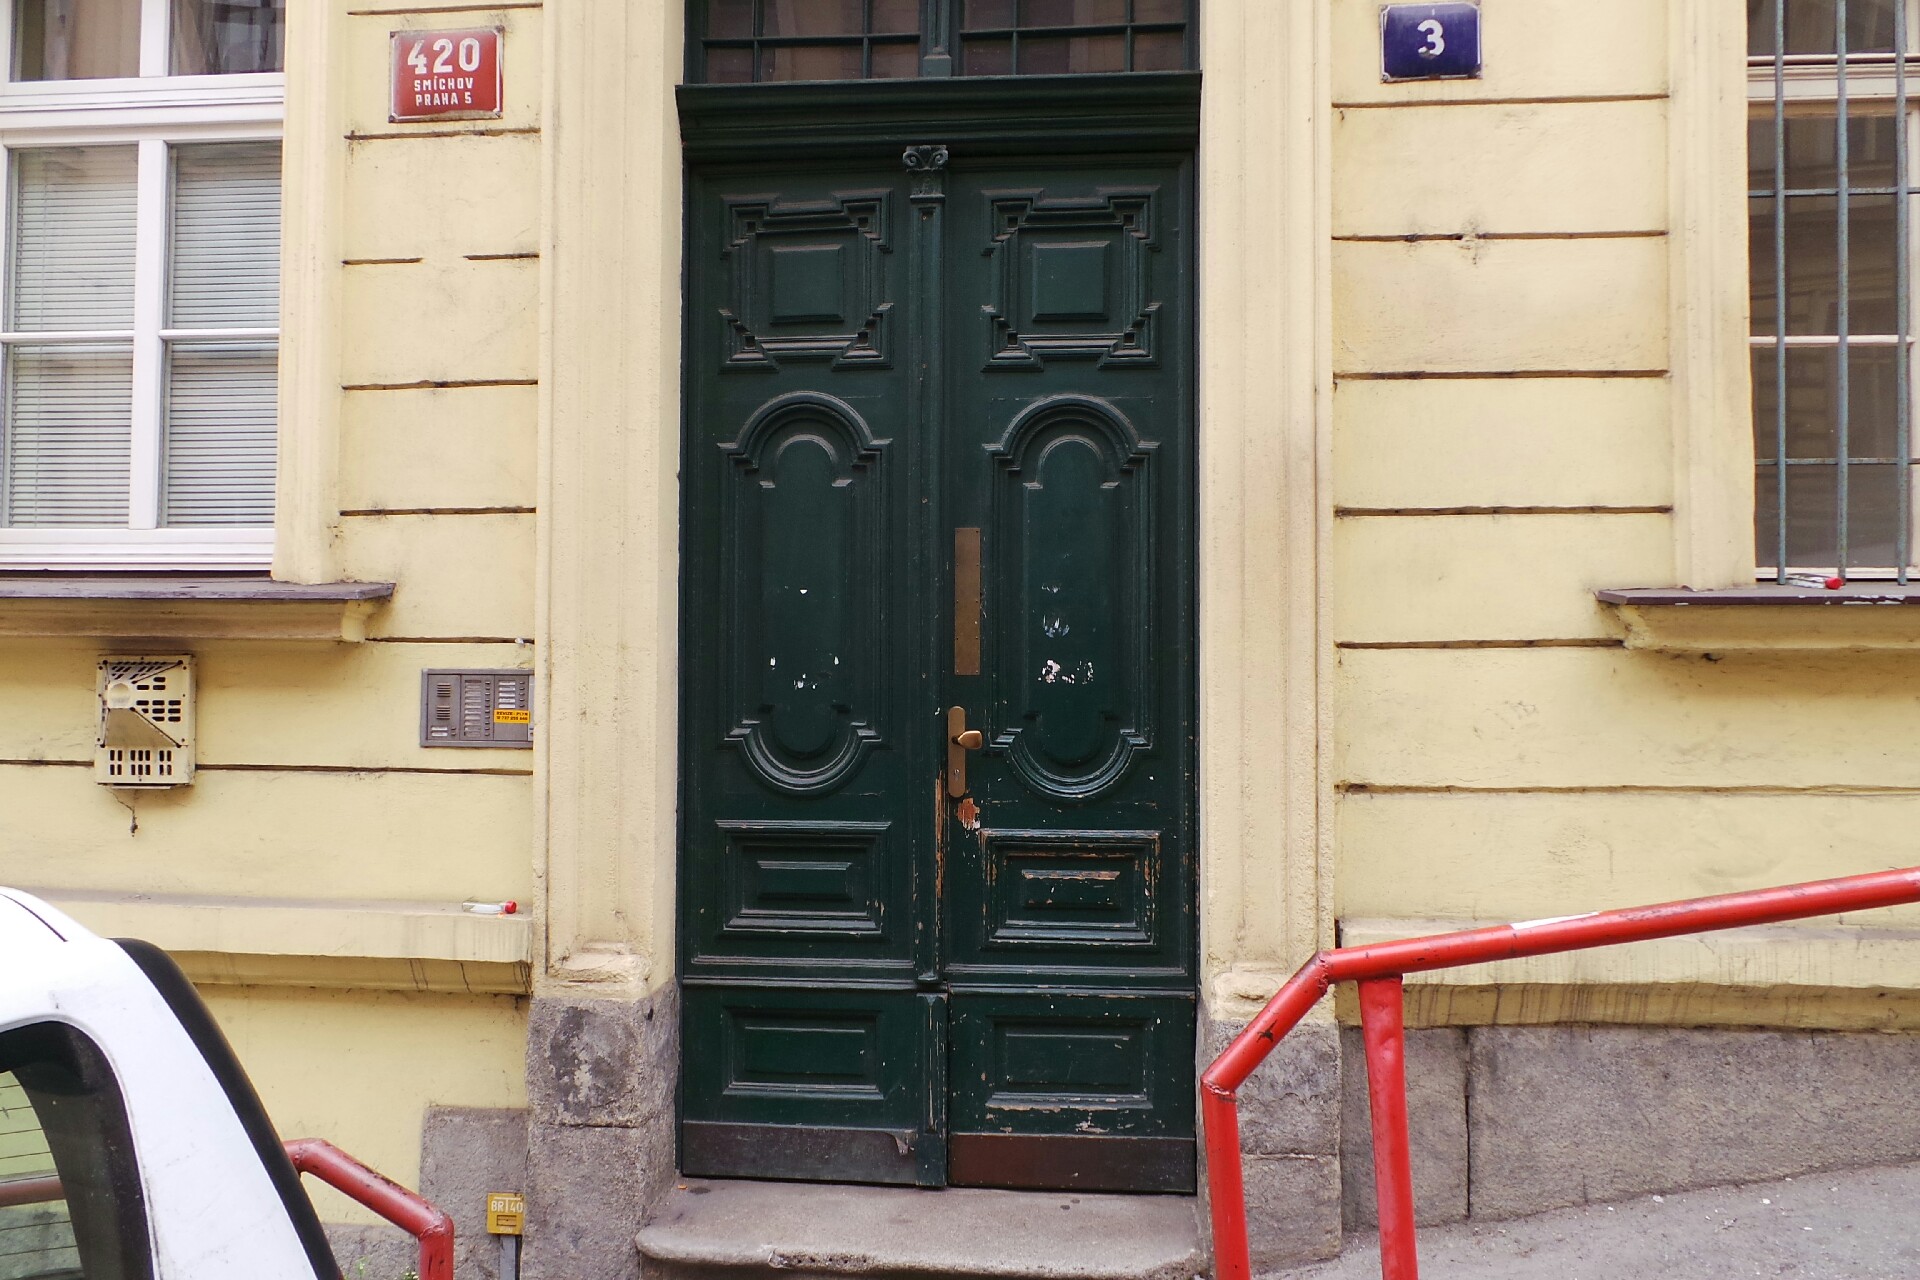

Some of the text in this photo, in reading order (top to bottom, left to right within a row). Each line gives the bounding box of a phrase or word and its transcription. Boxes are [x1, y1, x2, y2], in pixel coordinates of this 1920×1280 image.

[1417, 19, 1445, 57] 3
[407, 38, 480, 74] 420
[414, 76, 473, 91] SMÍCHOV
[416, 92, 472, 106] PRAHA 5
